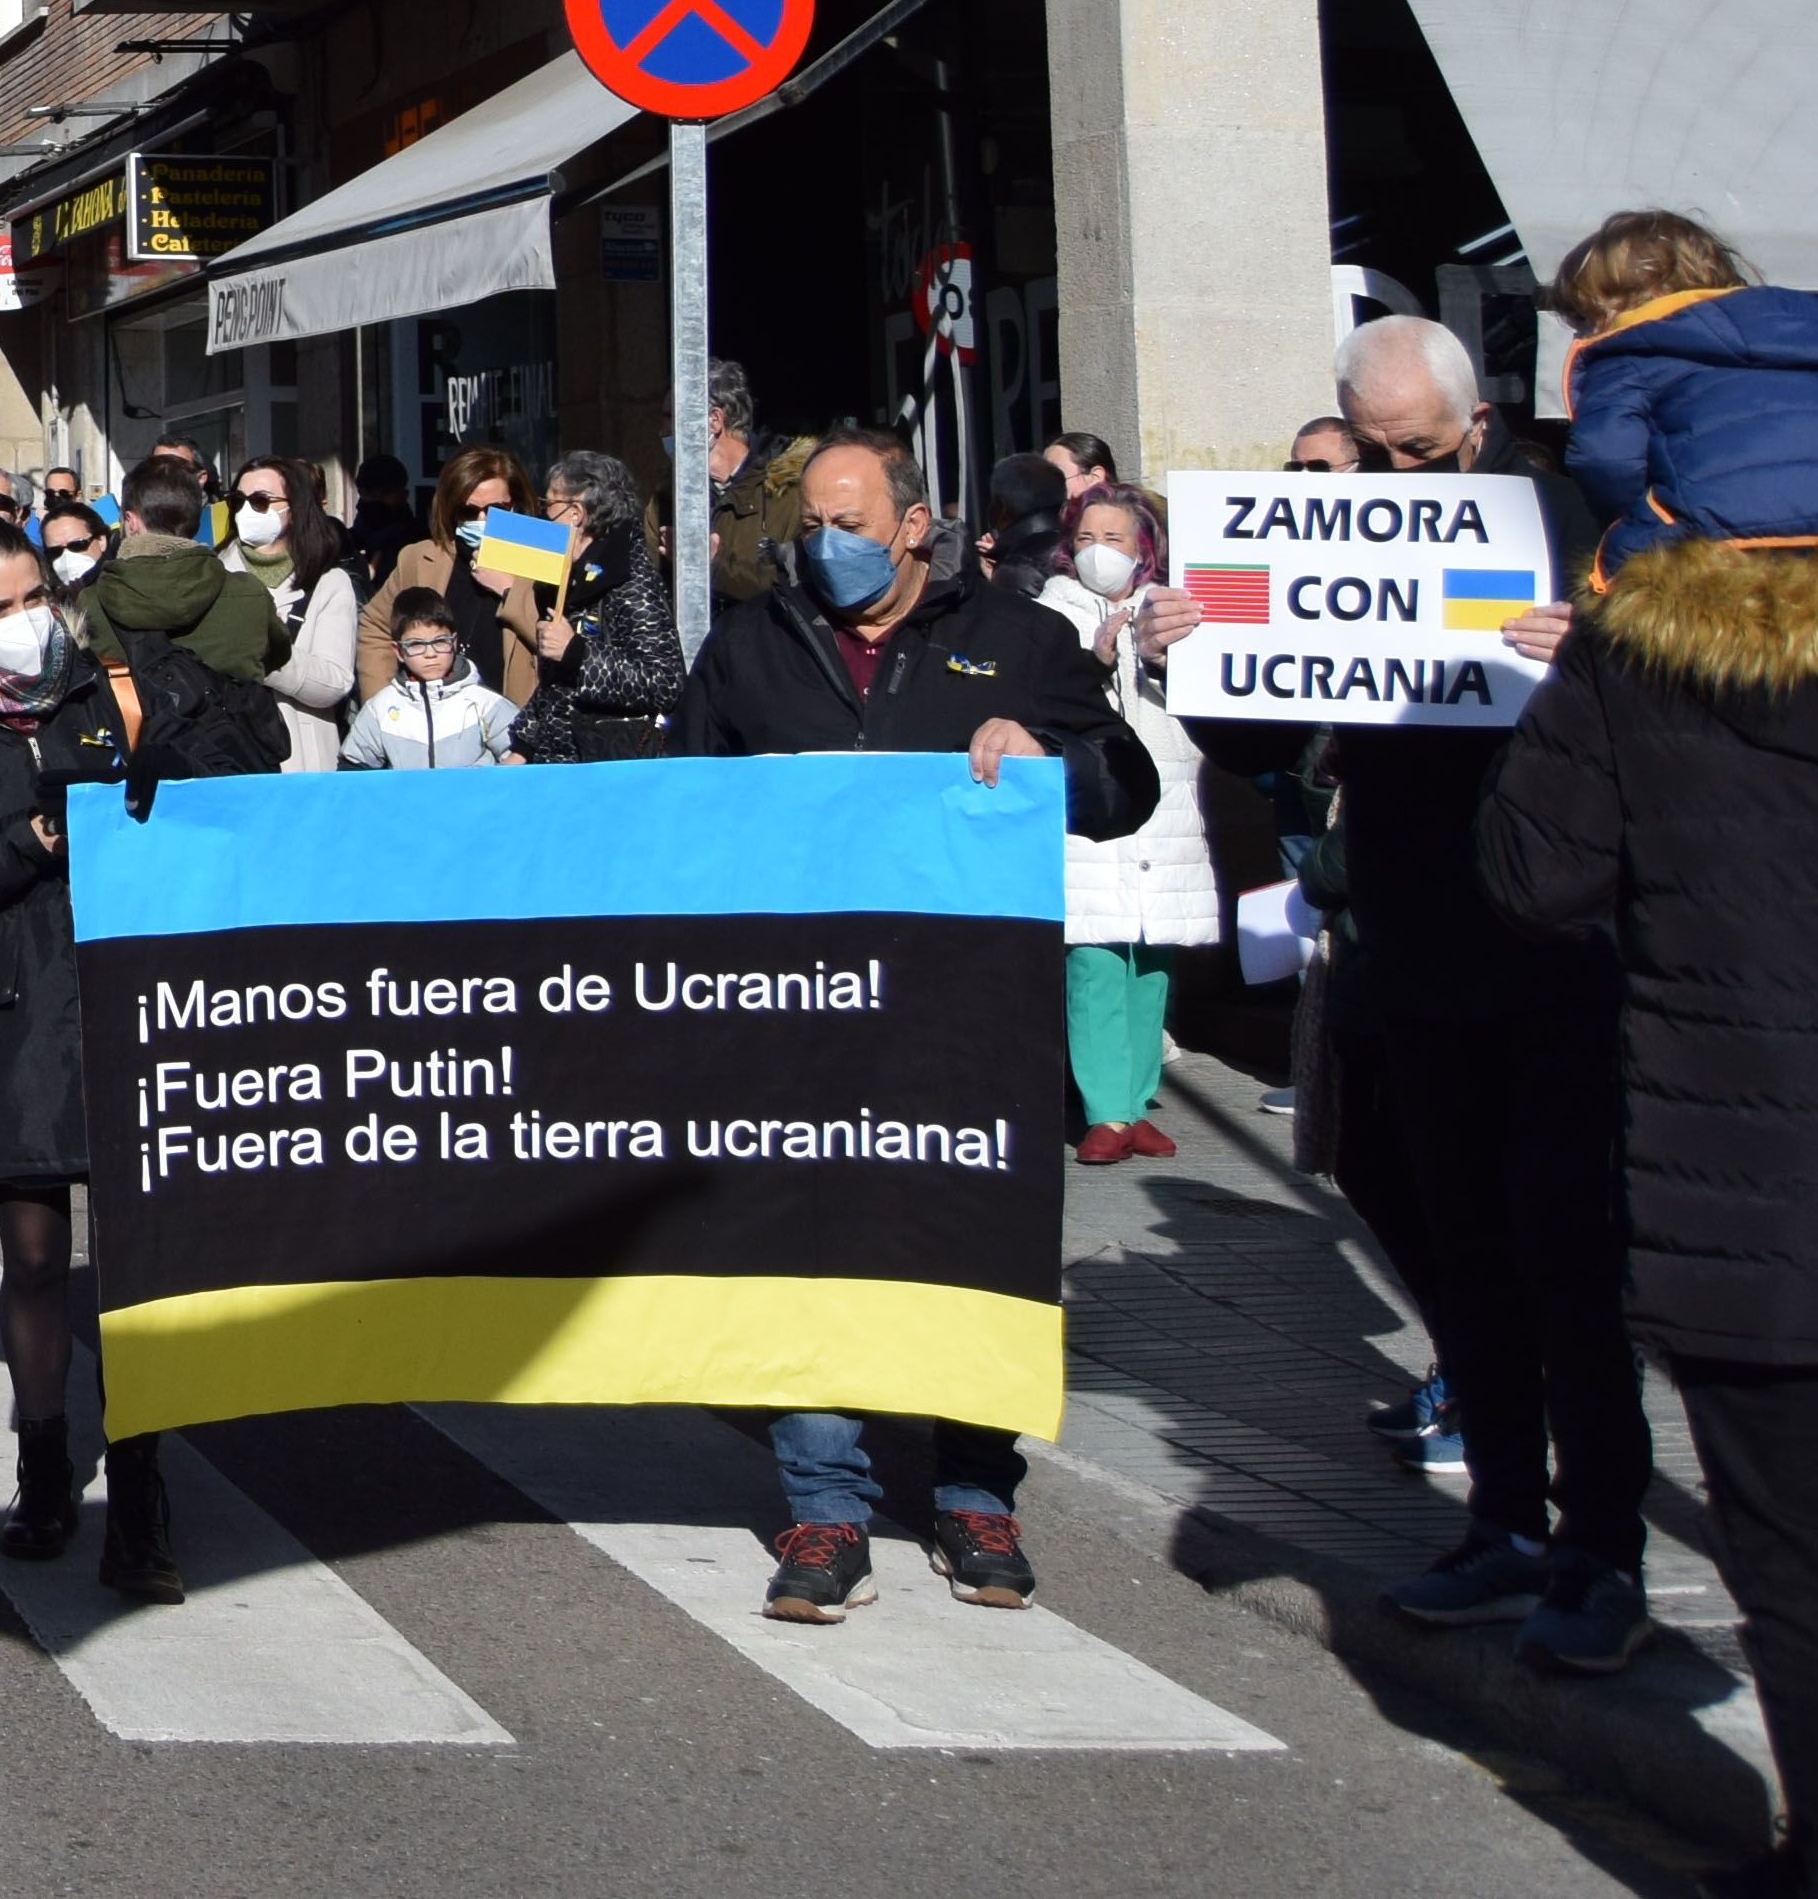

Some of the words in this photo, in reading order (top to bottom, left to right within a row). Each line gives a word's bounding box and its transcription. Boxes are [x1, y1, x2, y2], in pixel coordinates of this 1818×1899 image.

[1223, 497, 1489, 544] ZAMORA
[1287, 576, 1419, 622] CON
[1221, 653, 1493, 705] UCRANIA
[139, 978, 347, 1044] ¡Manos
[366, 967, 517, 1016] fuera
[539, 963, 611, 1013] de
[635, 959, 881, 1012] Ucrania!
[139, 1061, 322, 1127] ¡Fuera
[347, 1046, 513, 1097] Putin!
[140, 1125, 324, 1192] ¡Fuera
[345, 1112, 418, 1163] de
[440, 1112, 489, 1160] la
[510, 1110, 664, 1160] tierra
[687, 1107, 1009, 1170] ucraniana!
